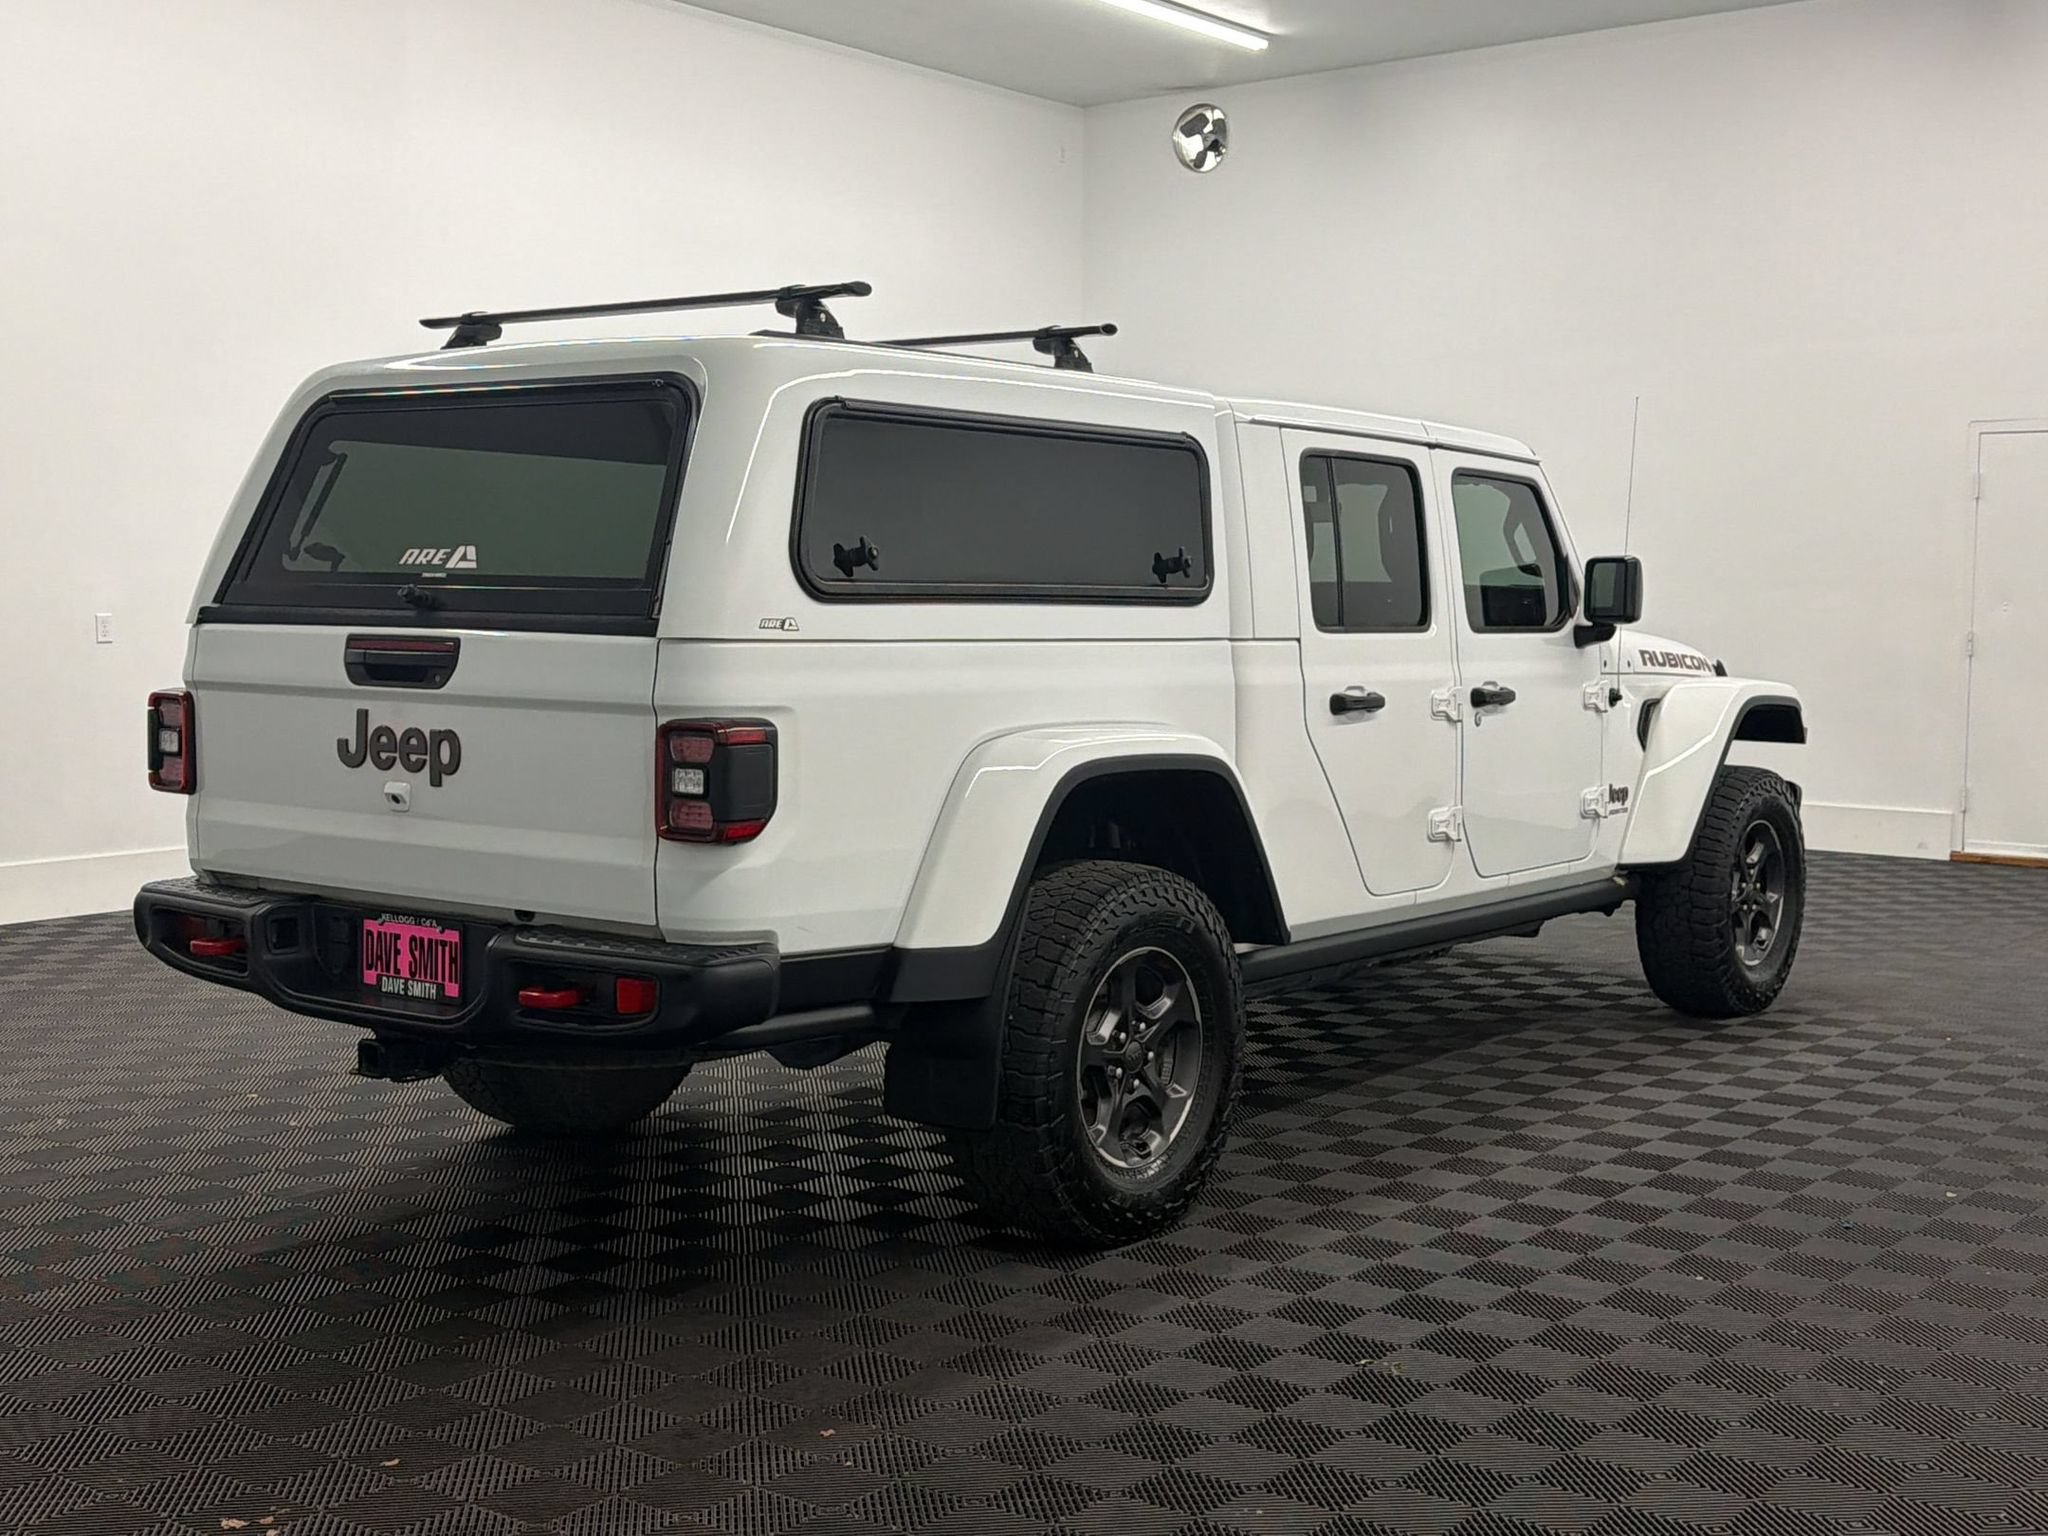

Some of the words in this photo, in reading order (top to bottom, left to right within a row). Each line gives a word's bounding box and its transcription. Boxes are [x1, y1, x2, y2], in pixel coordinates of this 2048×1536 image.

[1638, 649, 1712, 672] RUBICON
[337, 708, 461, 787] Jeep
[1606, 783, 1629, 806] Jeep
[381, 913, 415, 925] KELLOGG
[365, 928, 401, 975] DAVE
[408, 934, 459, 984] SMITH
[381, 976, 405, 995] DAVE
[407, 980, 437, 1000] SMITH
